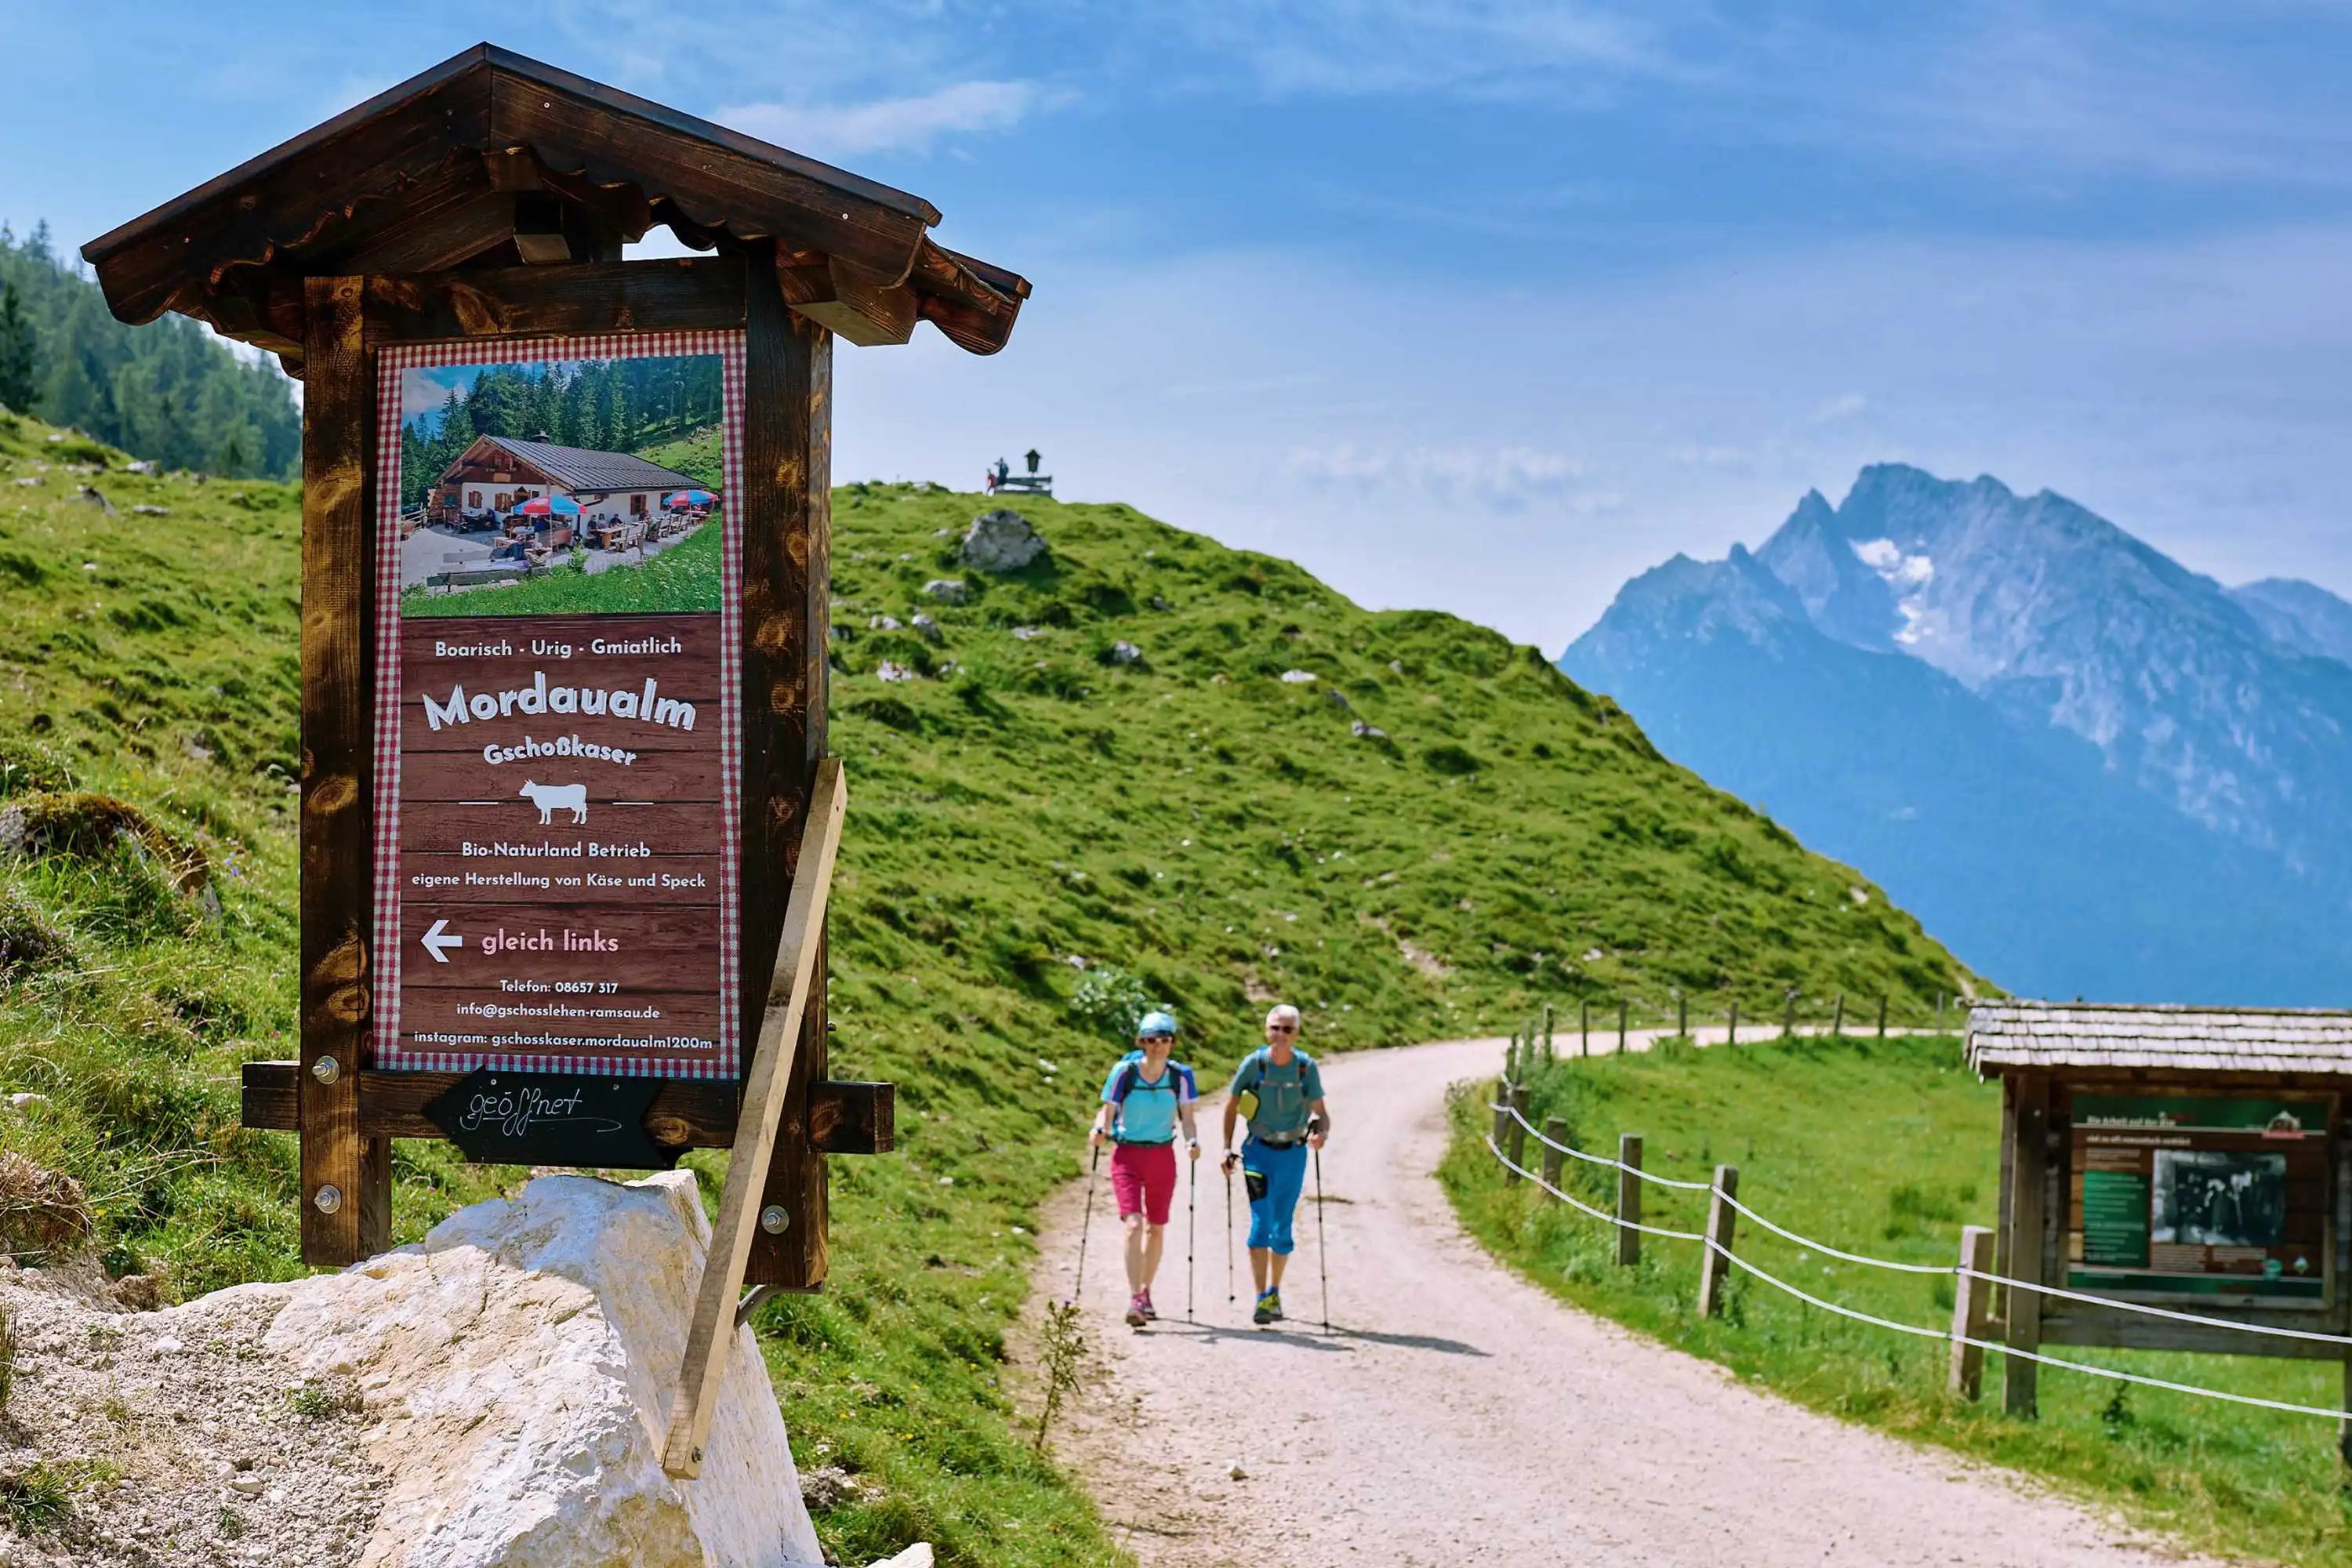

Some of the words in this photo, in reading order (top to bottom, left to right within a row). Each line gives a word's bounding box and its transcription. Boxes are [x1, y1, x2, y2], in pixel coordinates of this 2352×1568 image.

[435, 639, 512, 657] Boarisch
[532, 639, 572, 659] Urig
[591, 637, 682, 655] Gmiatlich
[422, 670, 697, 731] Mordaualm
[483, 734, 637, 766] Gschoßkaser
[462, 841, 582, 858] Bio-Naturland
[588, 842, 651, 858] Betrieb
[412, 873, 460, 888] eigene
[465, 872, 550, 889] Herstellung
[554, 877, 581, 887] von
[586, 873, 622, 887] Käse
[628, 873, 656, 887] und
[661, 873, 706, 890] Speck
[481, 928, 554, 955] gleich
[564, 928, 619, 952] links
[499, 979, 551, 993] Telefon:
[555, 982, 594, 993] 08657
[598, 982, 619, 994] 317
[456, 1003, 660, 1019] info@gschosslehen-ramsau.de
[414, 1031, 488, 1046] instagram:
[492, 1031, 713, 1049] gschosskaser.mordaualm1200m
[460, 1087, 583, 1136] geöffnet
